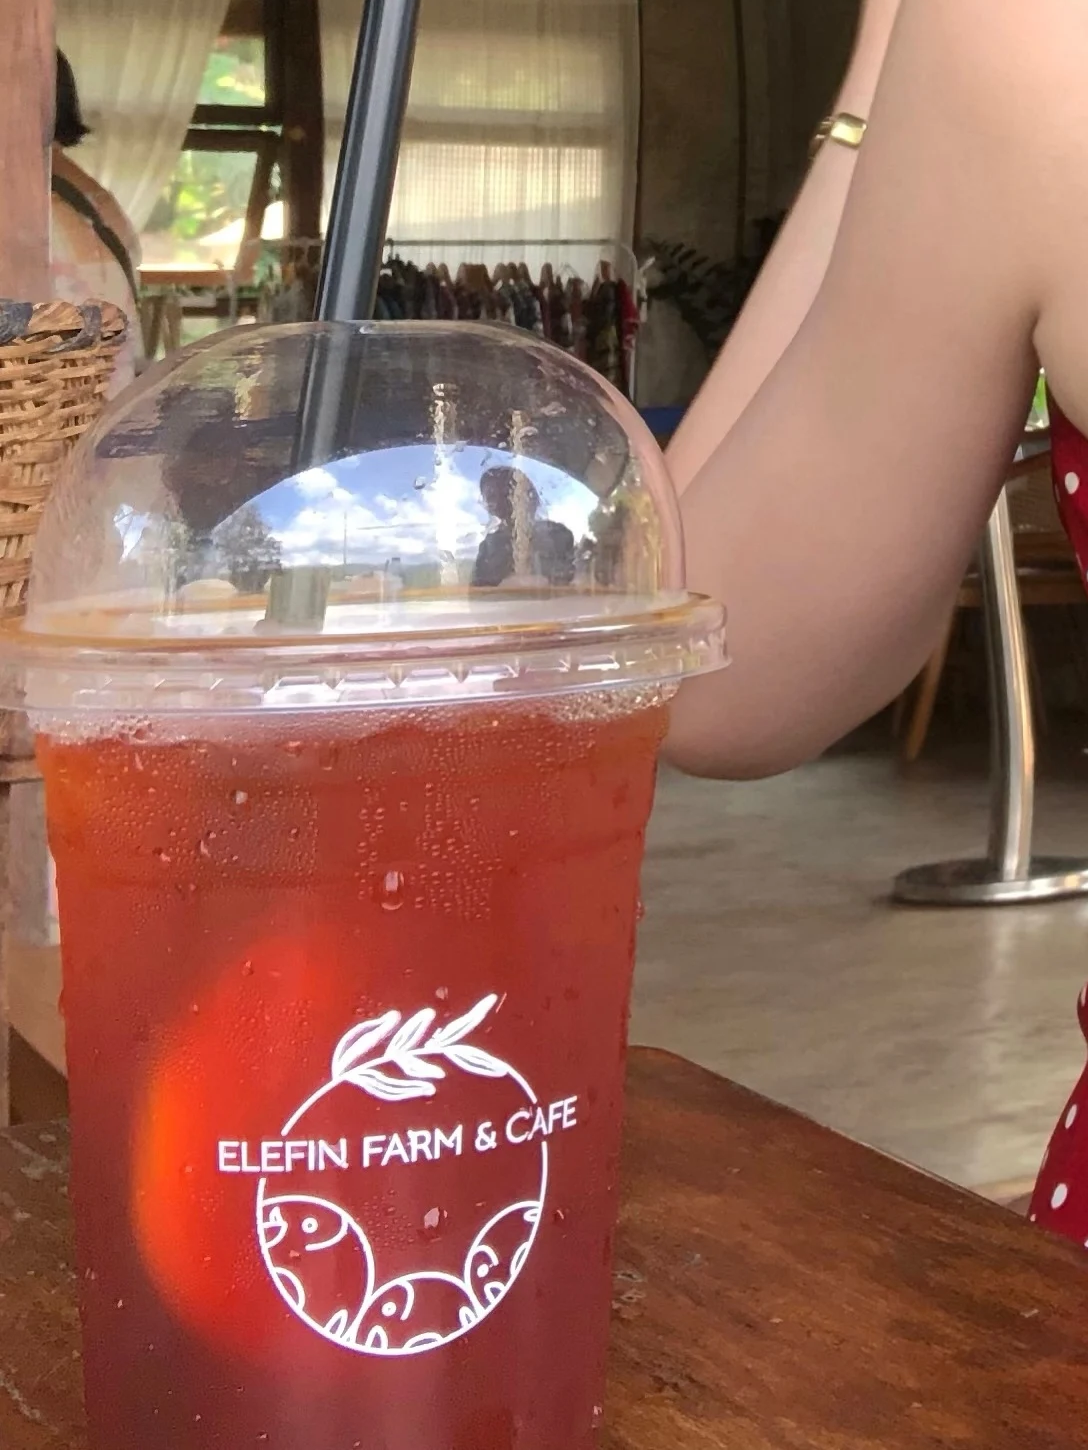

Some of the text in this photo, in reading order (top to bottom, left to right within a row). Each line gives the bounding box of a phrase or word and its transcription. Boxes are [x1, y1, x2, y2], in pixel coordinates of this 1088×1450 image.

[217, 1095, 579, 1173] ELEFIN FARM & CAFE
